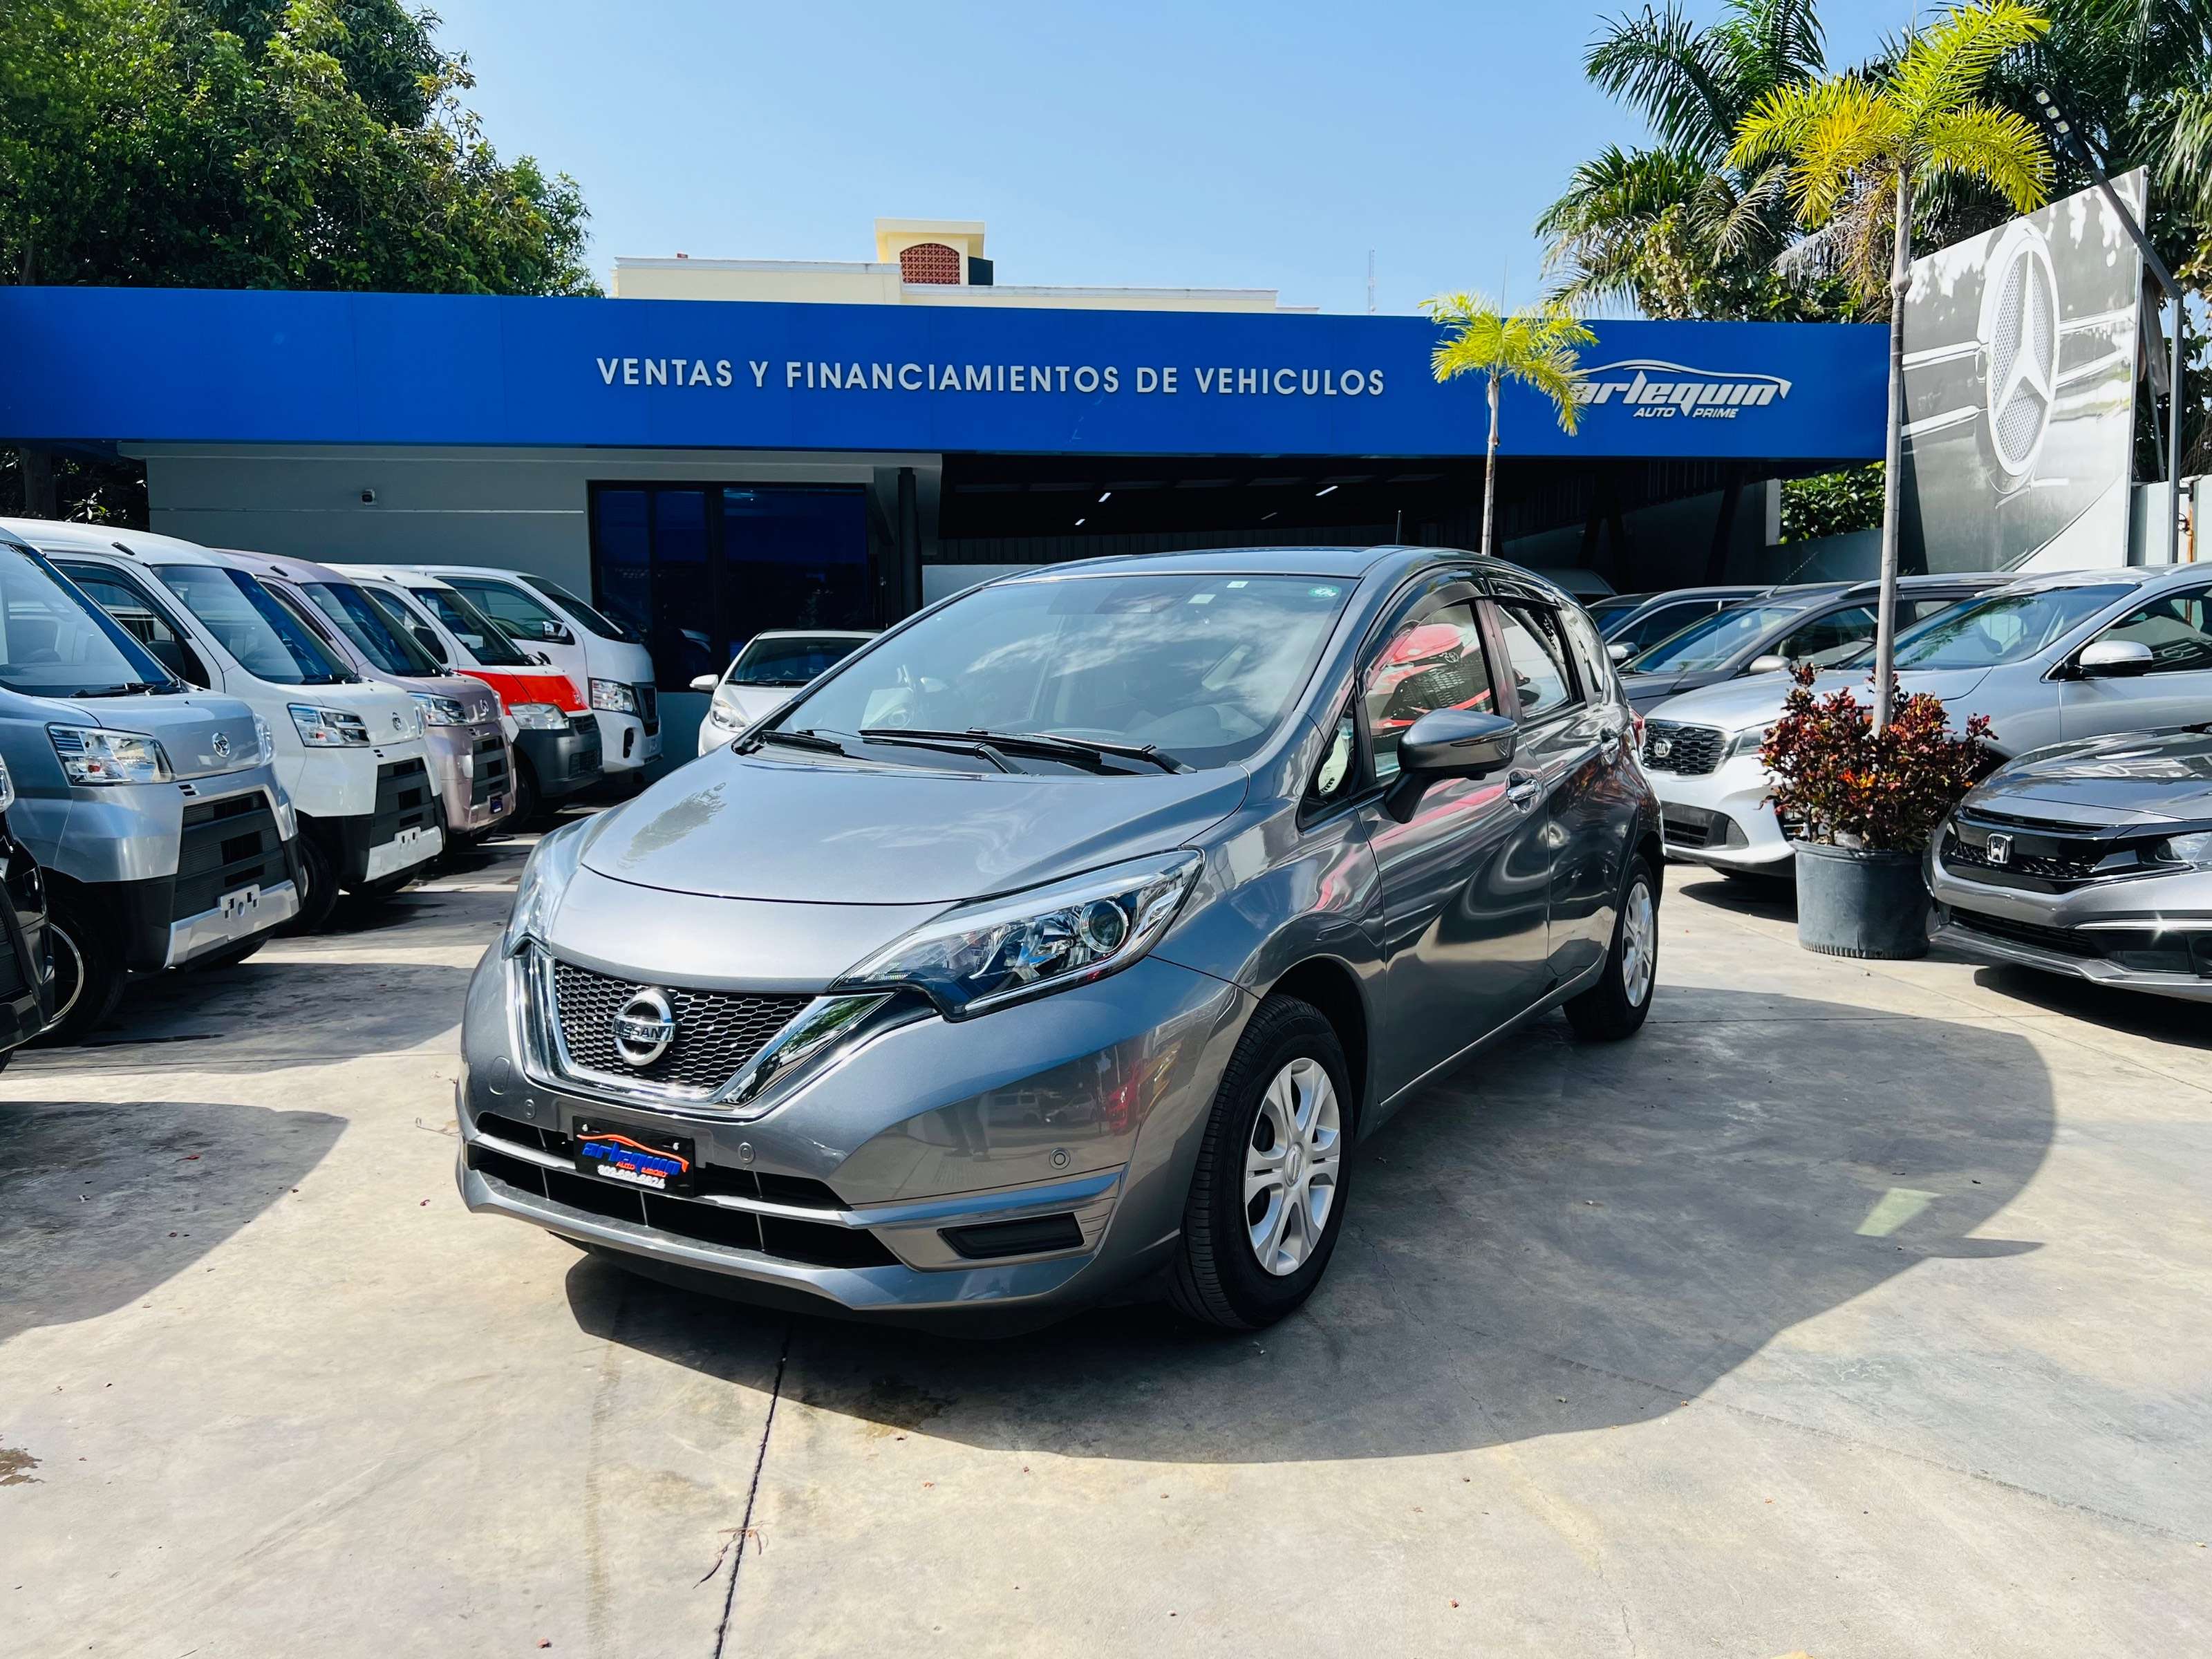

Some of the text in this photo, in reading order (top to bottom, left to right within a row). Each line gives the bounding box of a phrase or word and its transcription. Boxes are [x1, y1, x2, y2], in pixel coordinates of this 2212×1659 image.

[597, 358, 1383, 395] VENTAS Y FINANCIAMIENTOS DE VEHICULOS
[1633, 407, 1739, 419] AUTO PRIME
[616, 1161, 635, 1170] AUTO
